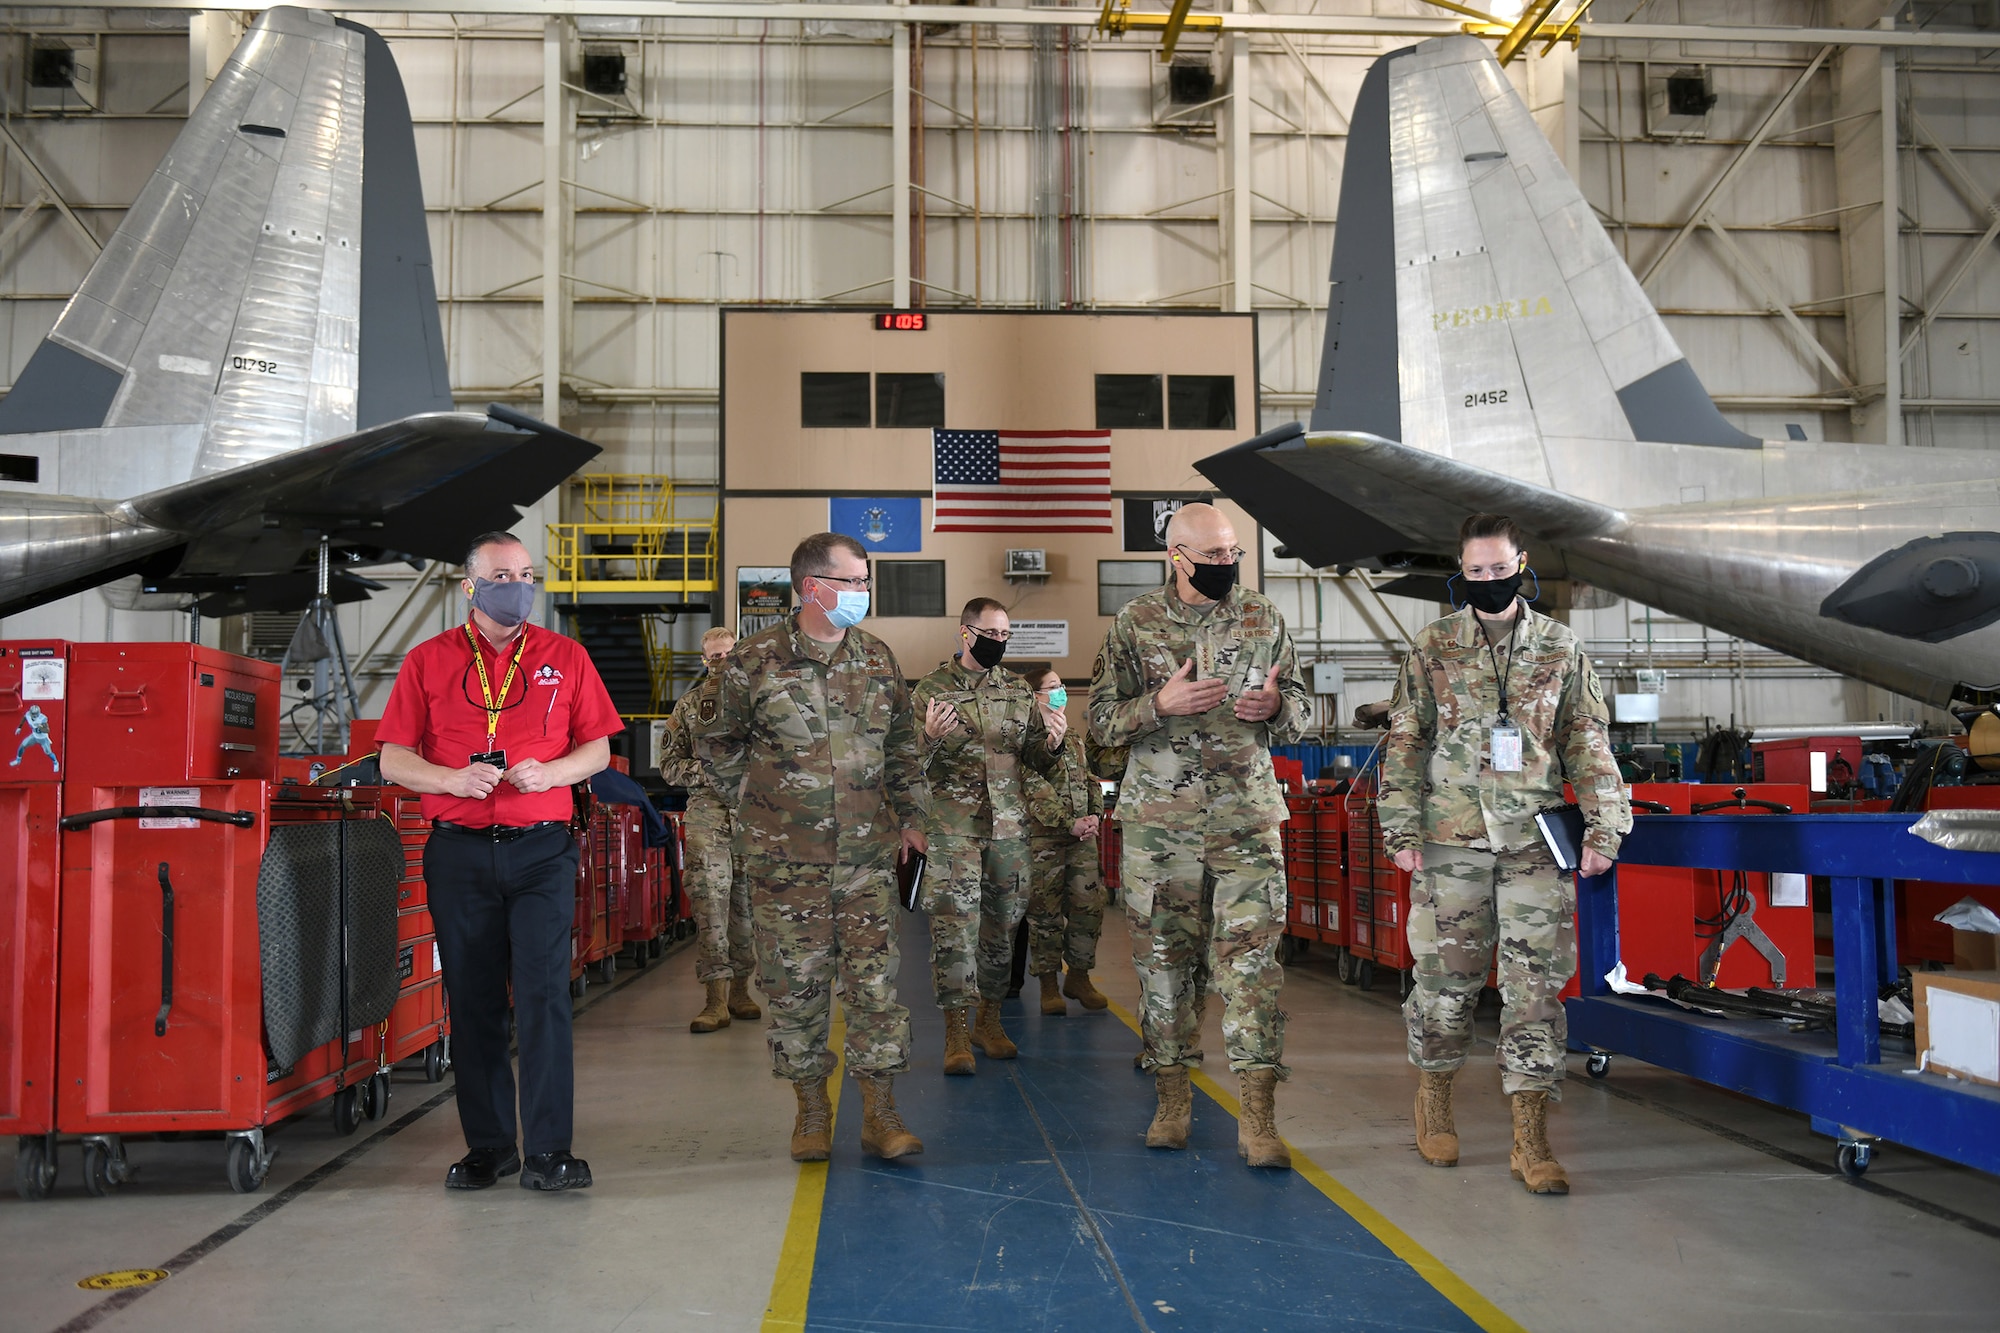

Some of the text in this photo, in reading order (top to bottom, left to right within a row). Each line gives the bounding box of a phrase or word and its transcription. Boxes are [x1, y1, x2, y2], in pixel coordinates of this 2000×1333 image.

[1431, 296, 1553, 331] PEORIA
[233, 356, 277, 374] 01792
[1464, 390, 1508, 408] 21452
[1244, 630, 1254, 638] AIR
[1254, 629, 1272, 638] FORCE
[1547, 650, 1569, 662] FORCE
[477, 658, 488, 688] SUPERVISOR
